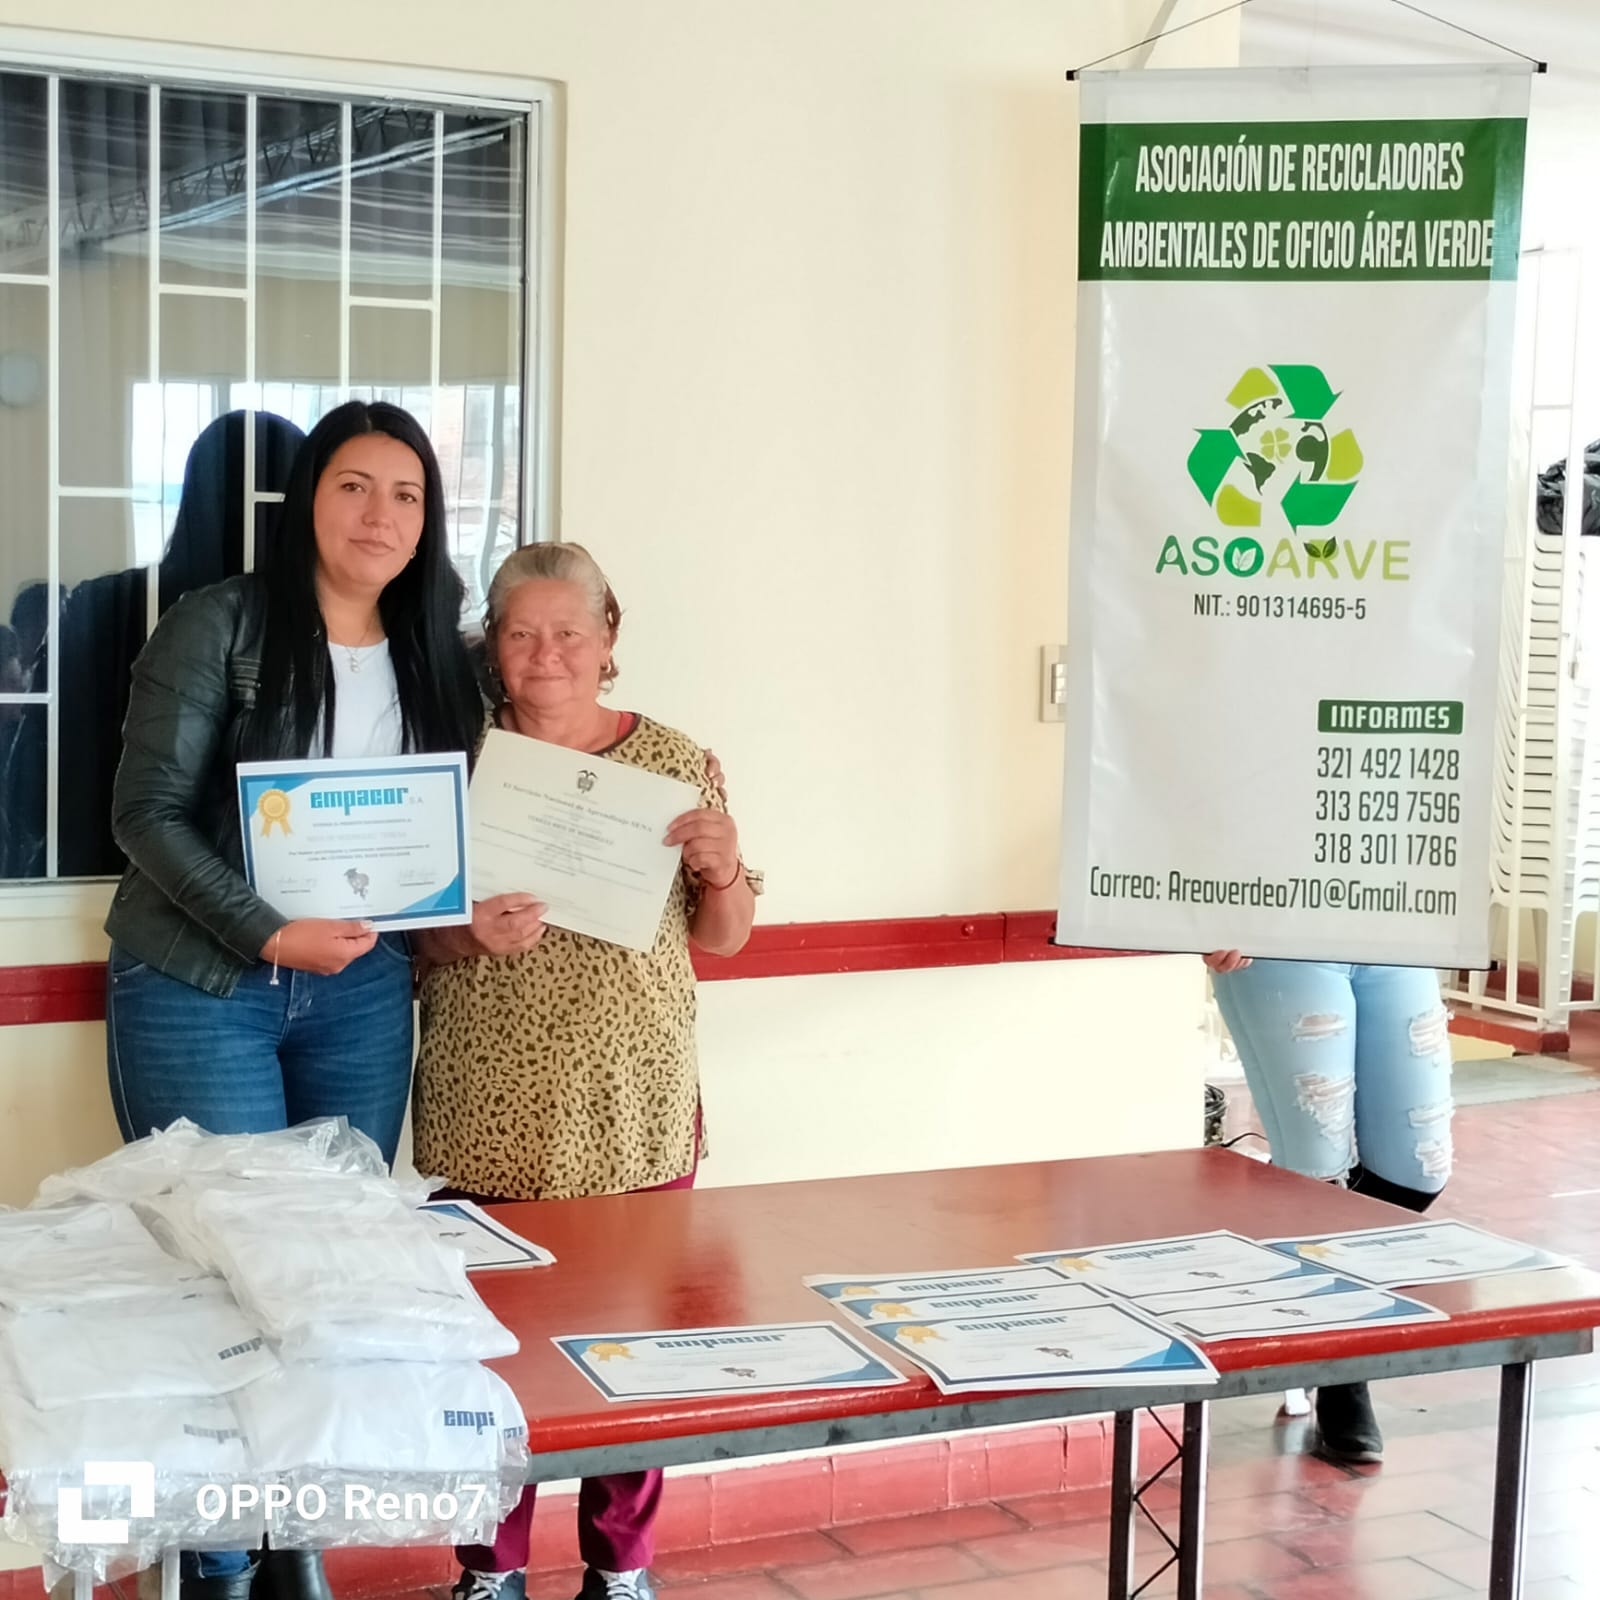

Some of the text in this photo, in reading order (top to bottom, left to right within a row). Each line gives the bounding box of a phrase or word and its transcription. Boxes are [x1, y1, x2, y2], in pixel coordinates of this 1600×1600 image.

[1135, 134, 1464, 193] ASOCIACIÓN DE RECICLADORES
[1100, 211, 1495, 269] AMBIENTALES DE OFICIO ÁREA VERDE
[1155, 535, 1411, 581] ASOARVE
[1194, 594, 1367, 620] NIT.: 901314695-5
[1330, 704, 1450, 729] INFORMES
[1317, 747, 1460, 780] 321 492 1428
[310, 787, 408, 816] empacor
[1315, 790, 1460, 824] 313 629 7596
[1314, 832, 1457, 867] 318 301 1786
[1090, 866, 1161, 900] Correo:
[655, 1334, 787, 1349] empacor
